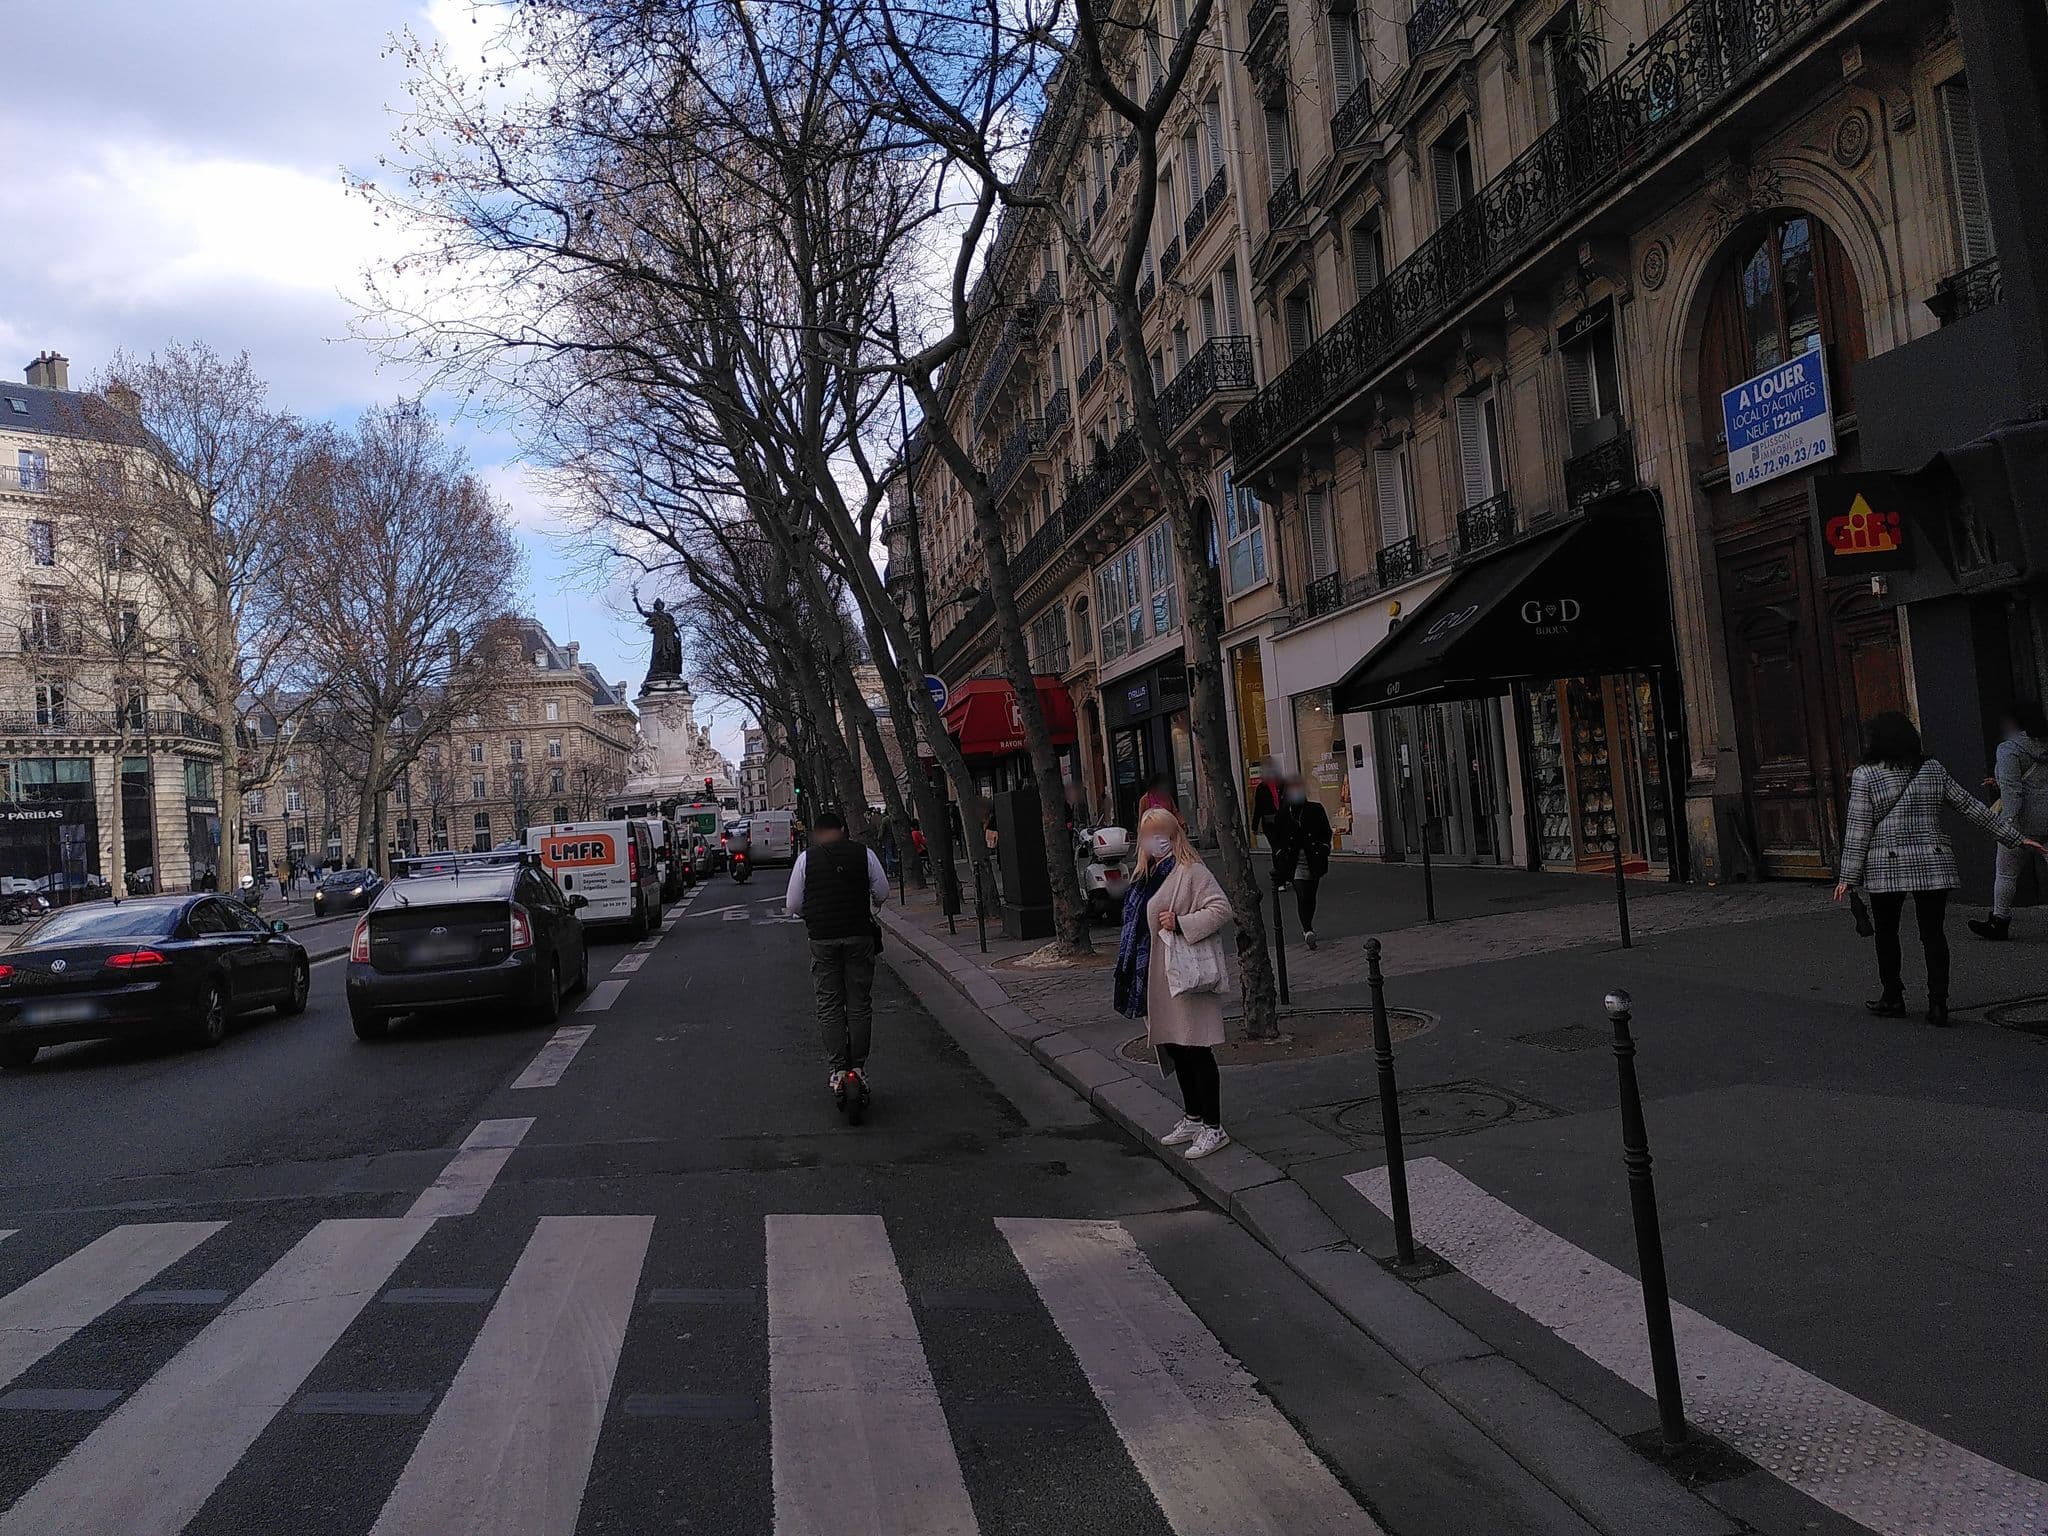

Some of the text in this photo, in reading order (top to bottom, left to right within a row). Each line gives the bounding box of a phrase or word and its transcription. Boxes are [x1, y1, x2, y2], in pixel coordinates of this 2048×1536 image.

[1739, 363, 1806, 410] A LOUER
[1732, 381, 1816, 430] LOCAL D'ACTIVITÉS
[1746, 421, 1769, 442] NEUF
[1760, 437, 1805, 461] IMMOBILIER
[1735, 439, 1826, 486] 01.45.72.99.23/20
[8, 810, 63, 820] PARIBAS
[551, 842, 606, 861] LMFR
